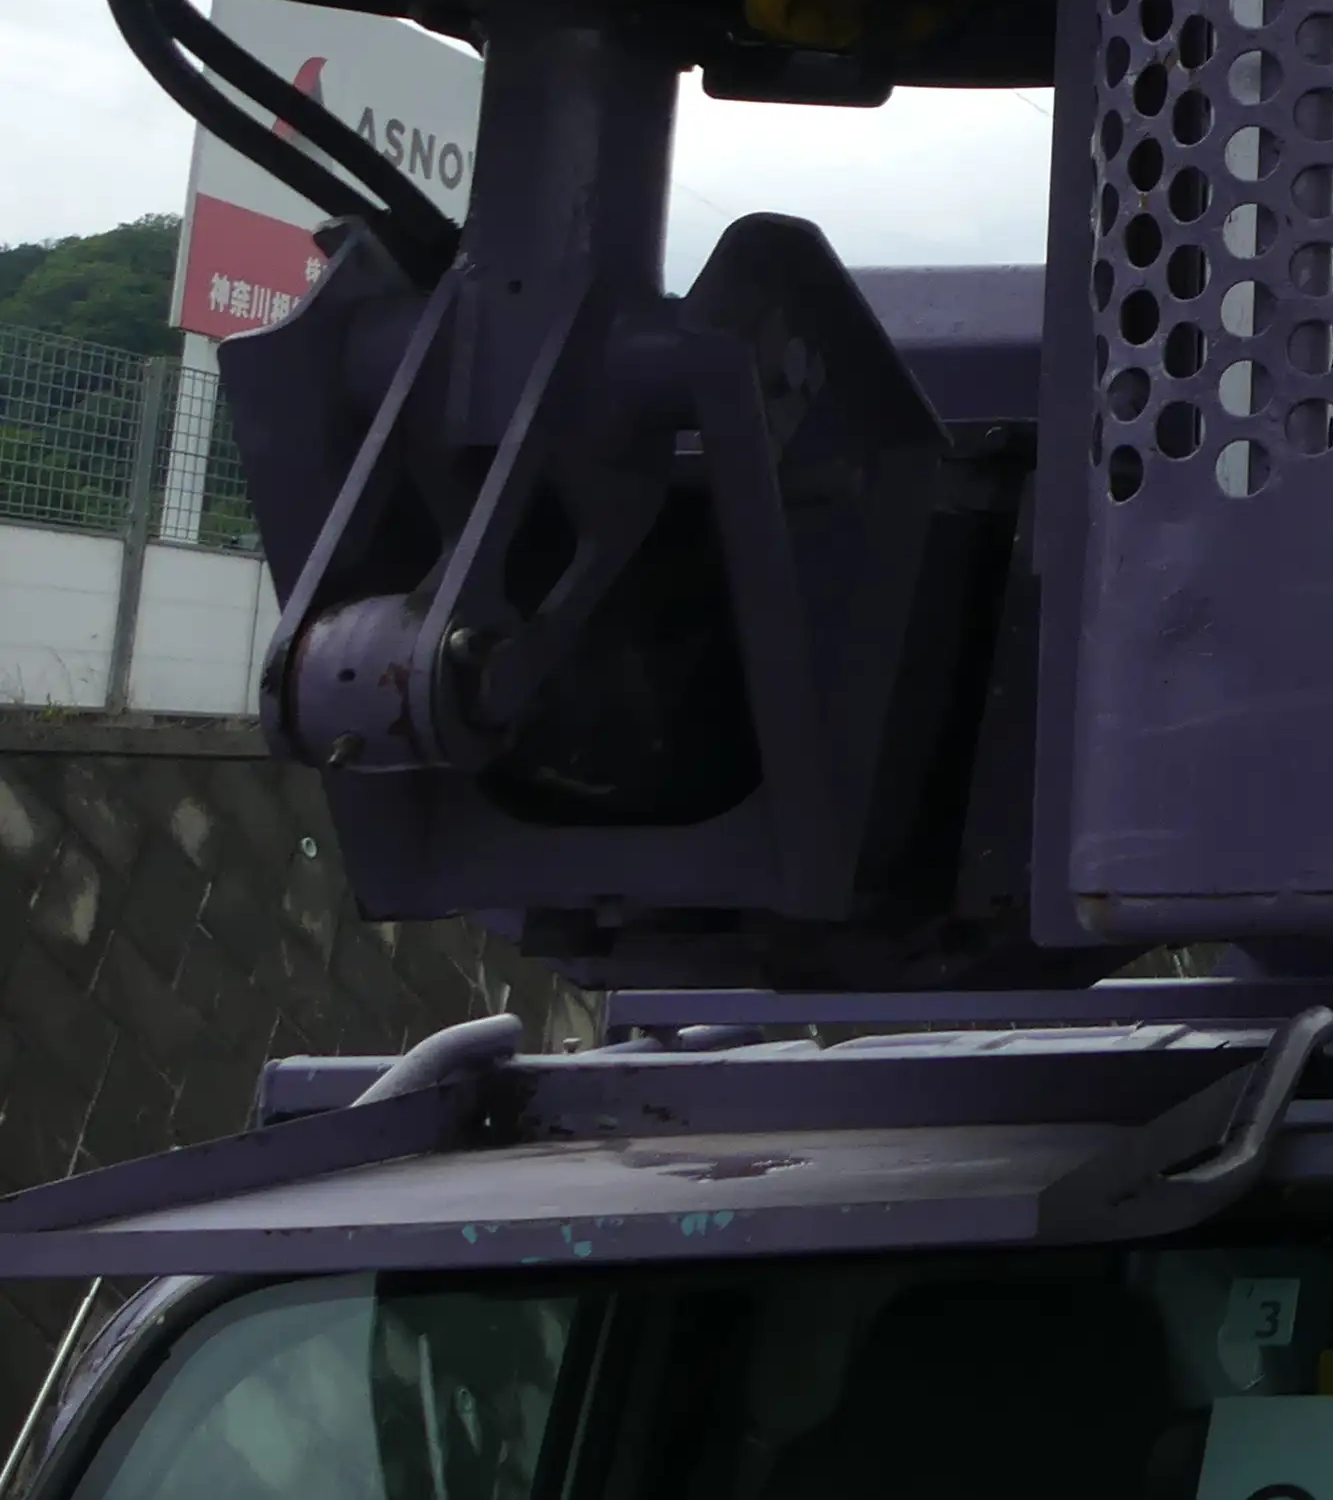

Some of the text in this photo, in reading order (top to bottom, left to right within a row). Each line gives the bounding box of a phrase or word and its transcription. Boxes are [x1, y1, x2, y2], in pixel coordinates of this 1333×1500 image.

[356, 106, 474, 190] ASNO
[209, 271, 300, 324] 神奈川相
[1254, 1300, 1281, 1338] 3
